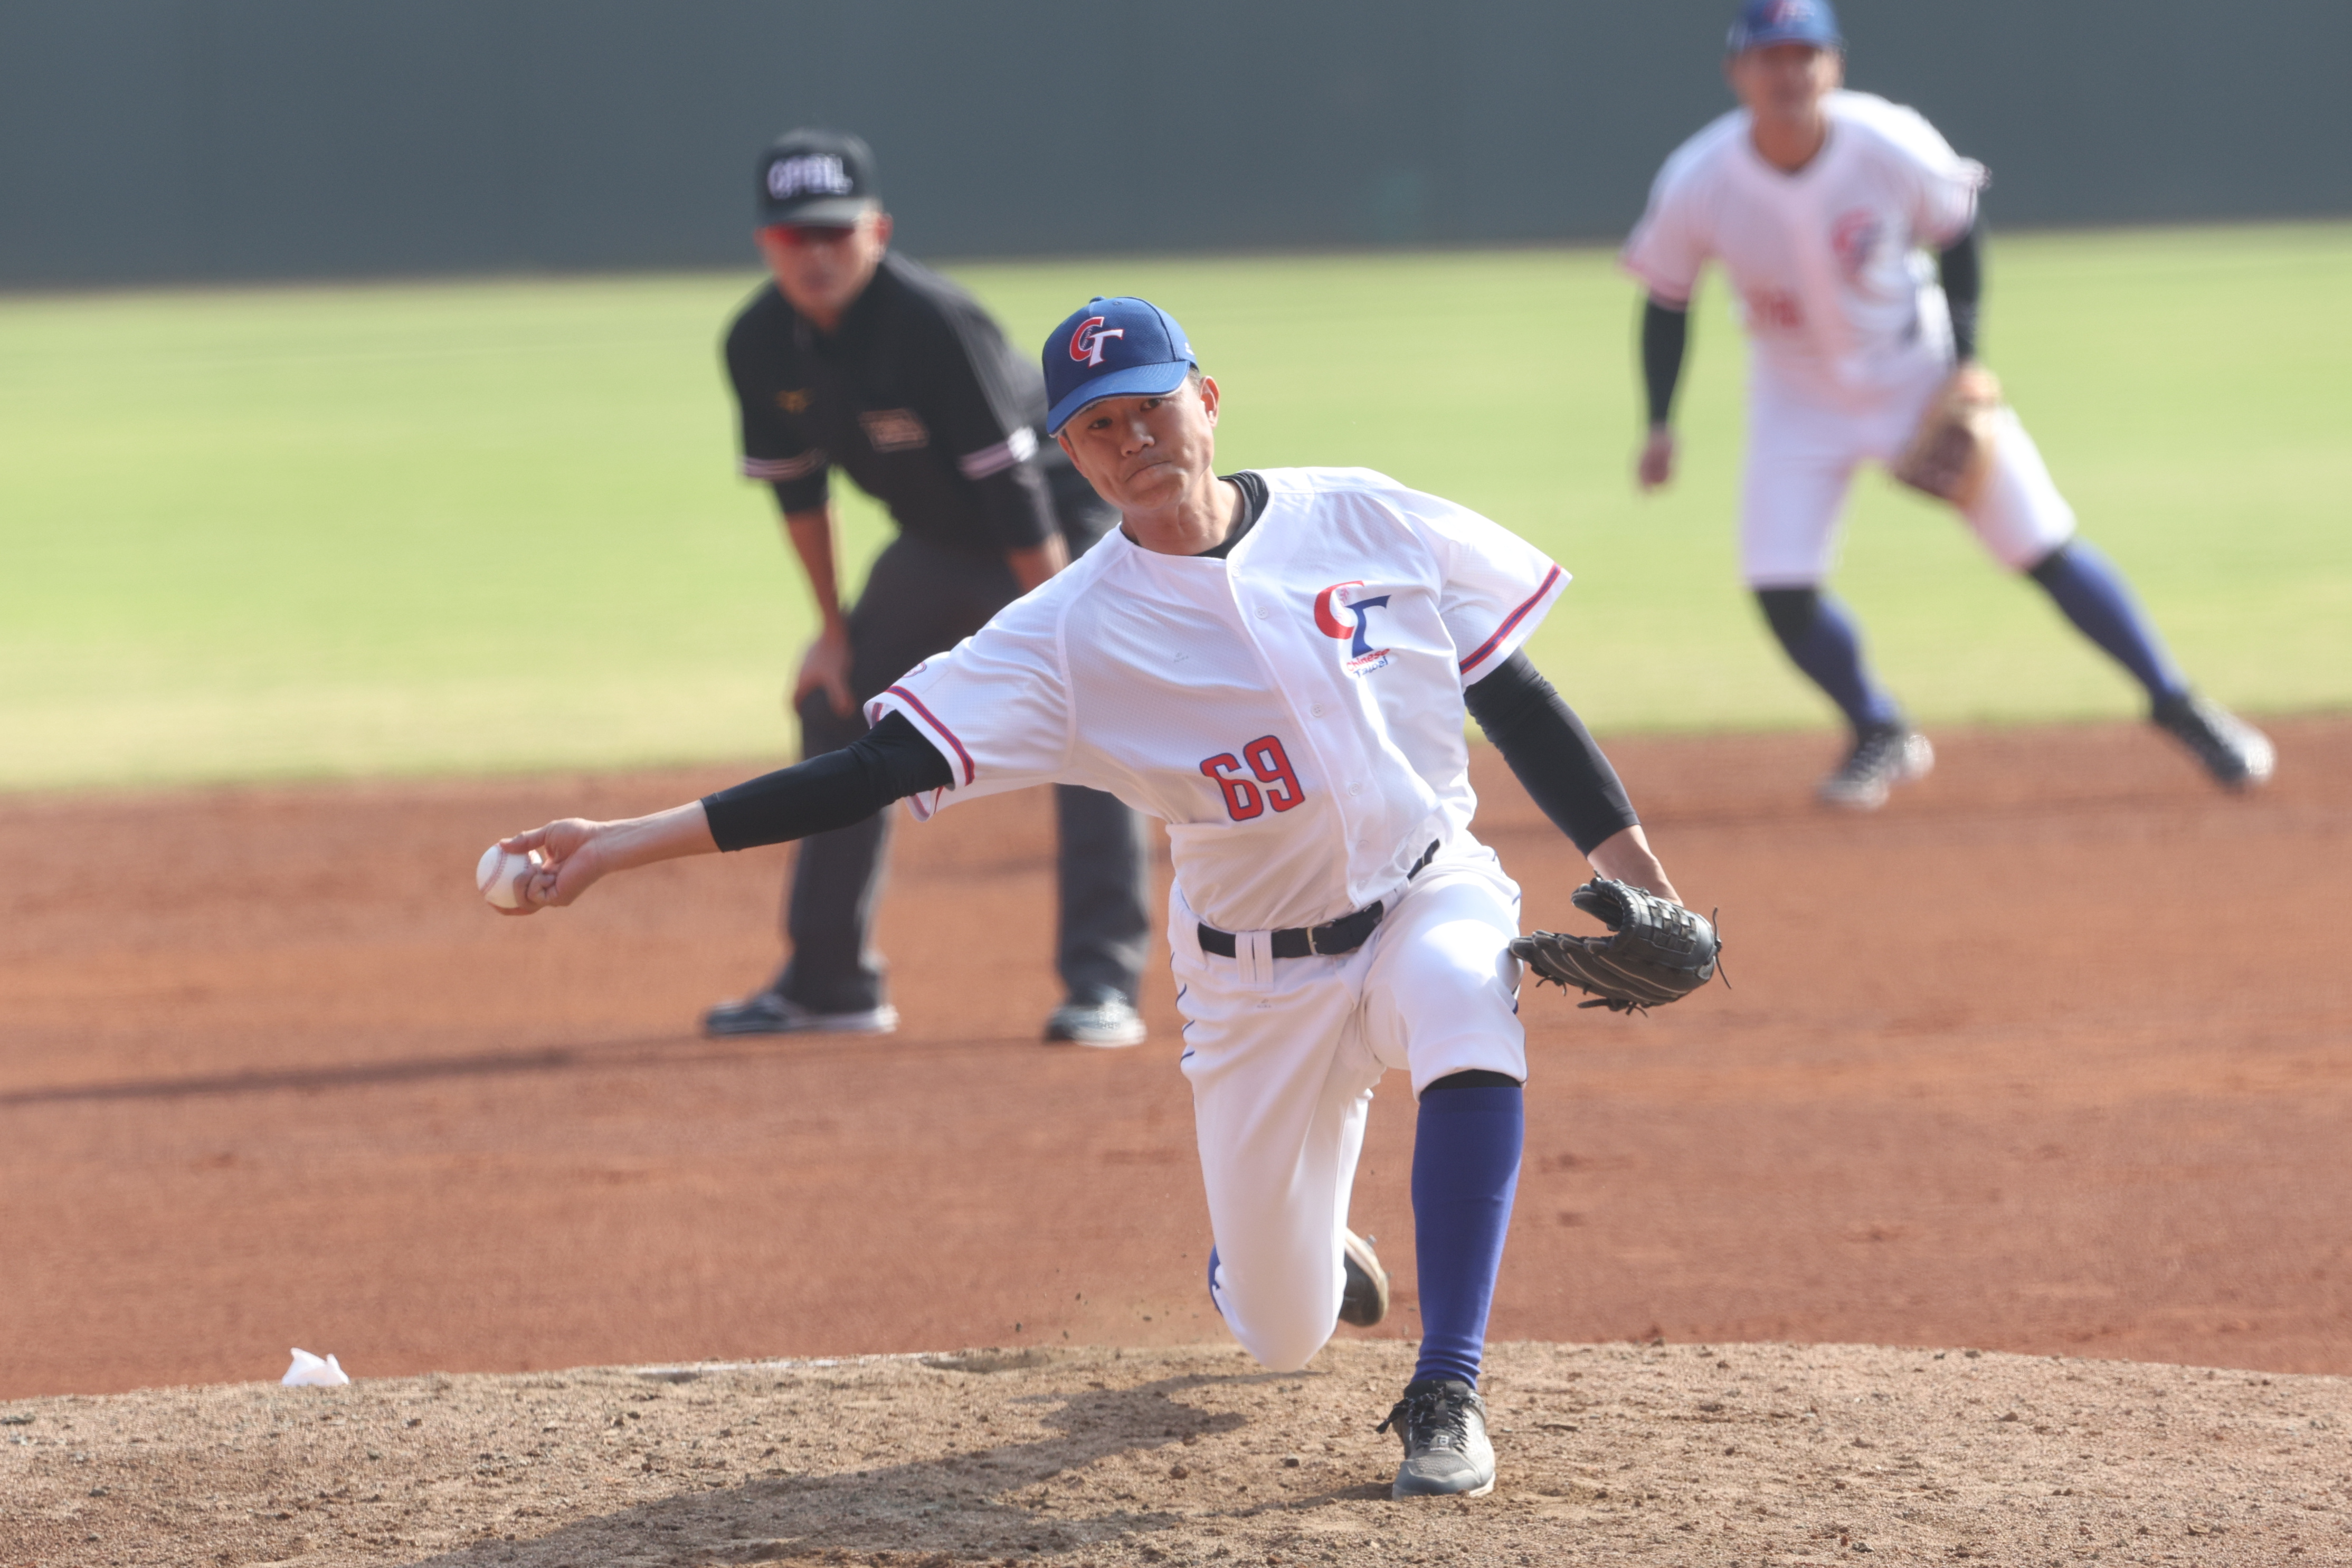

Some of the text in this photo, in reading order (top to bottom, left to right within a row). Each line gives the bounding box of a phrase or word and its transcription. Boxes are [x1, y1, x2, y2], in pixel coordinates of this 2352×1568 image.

[1346, 649, 1390, 672] Chinese
[1353, 655, 1388, 678] Taipei
[1199, 734, 1305, 821] 69
